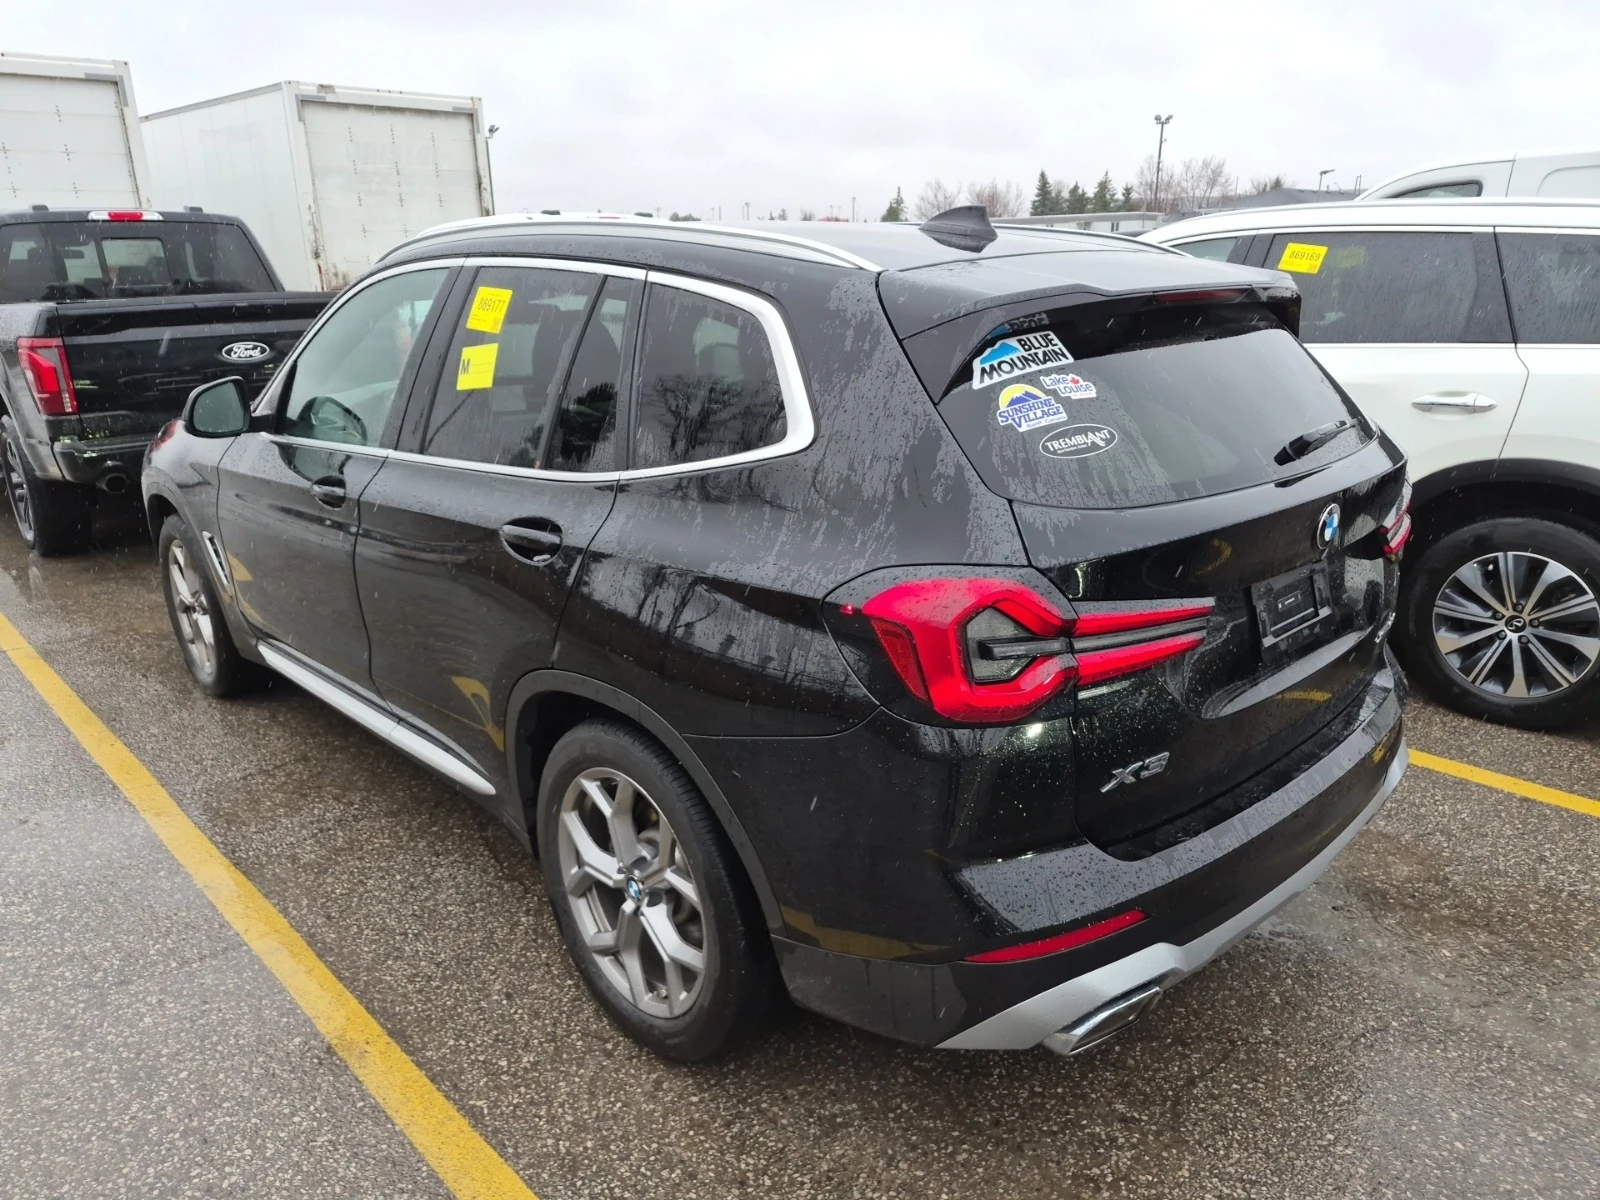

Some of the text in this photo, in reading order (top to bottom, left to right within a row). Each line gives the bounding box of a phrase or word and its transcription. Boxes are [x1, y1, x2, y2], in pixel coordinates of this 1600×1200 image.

[1289, 250, 1321, 262] 869169
[477, 297, 506, 313] 869177
[231, 344, 261, 358] Ford
[1016, 333, 1059, 352] BLUE
[460, 358, 471, 375] M
[979, 348, 1070, 384] MOUNTAIN
[1041, 376, 1069, 387] Lake
[1057, 383, 1094, 395] Louise
[998, 398, 1055, 424] SUNSHINE
[1011, 405, 1063, 429] VILLAGE
[1045, 429, 1110, 451] TREMBLANT
[1100, 751, 1170, 793] X3
